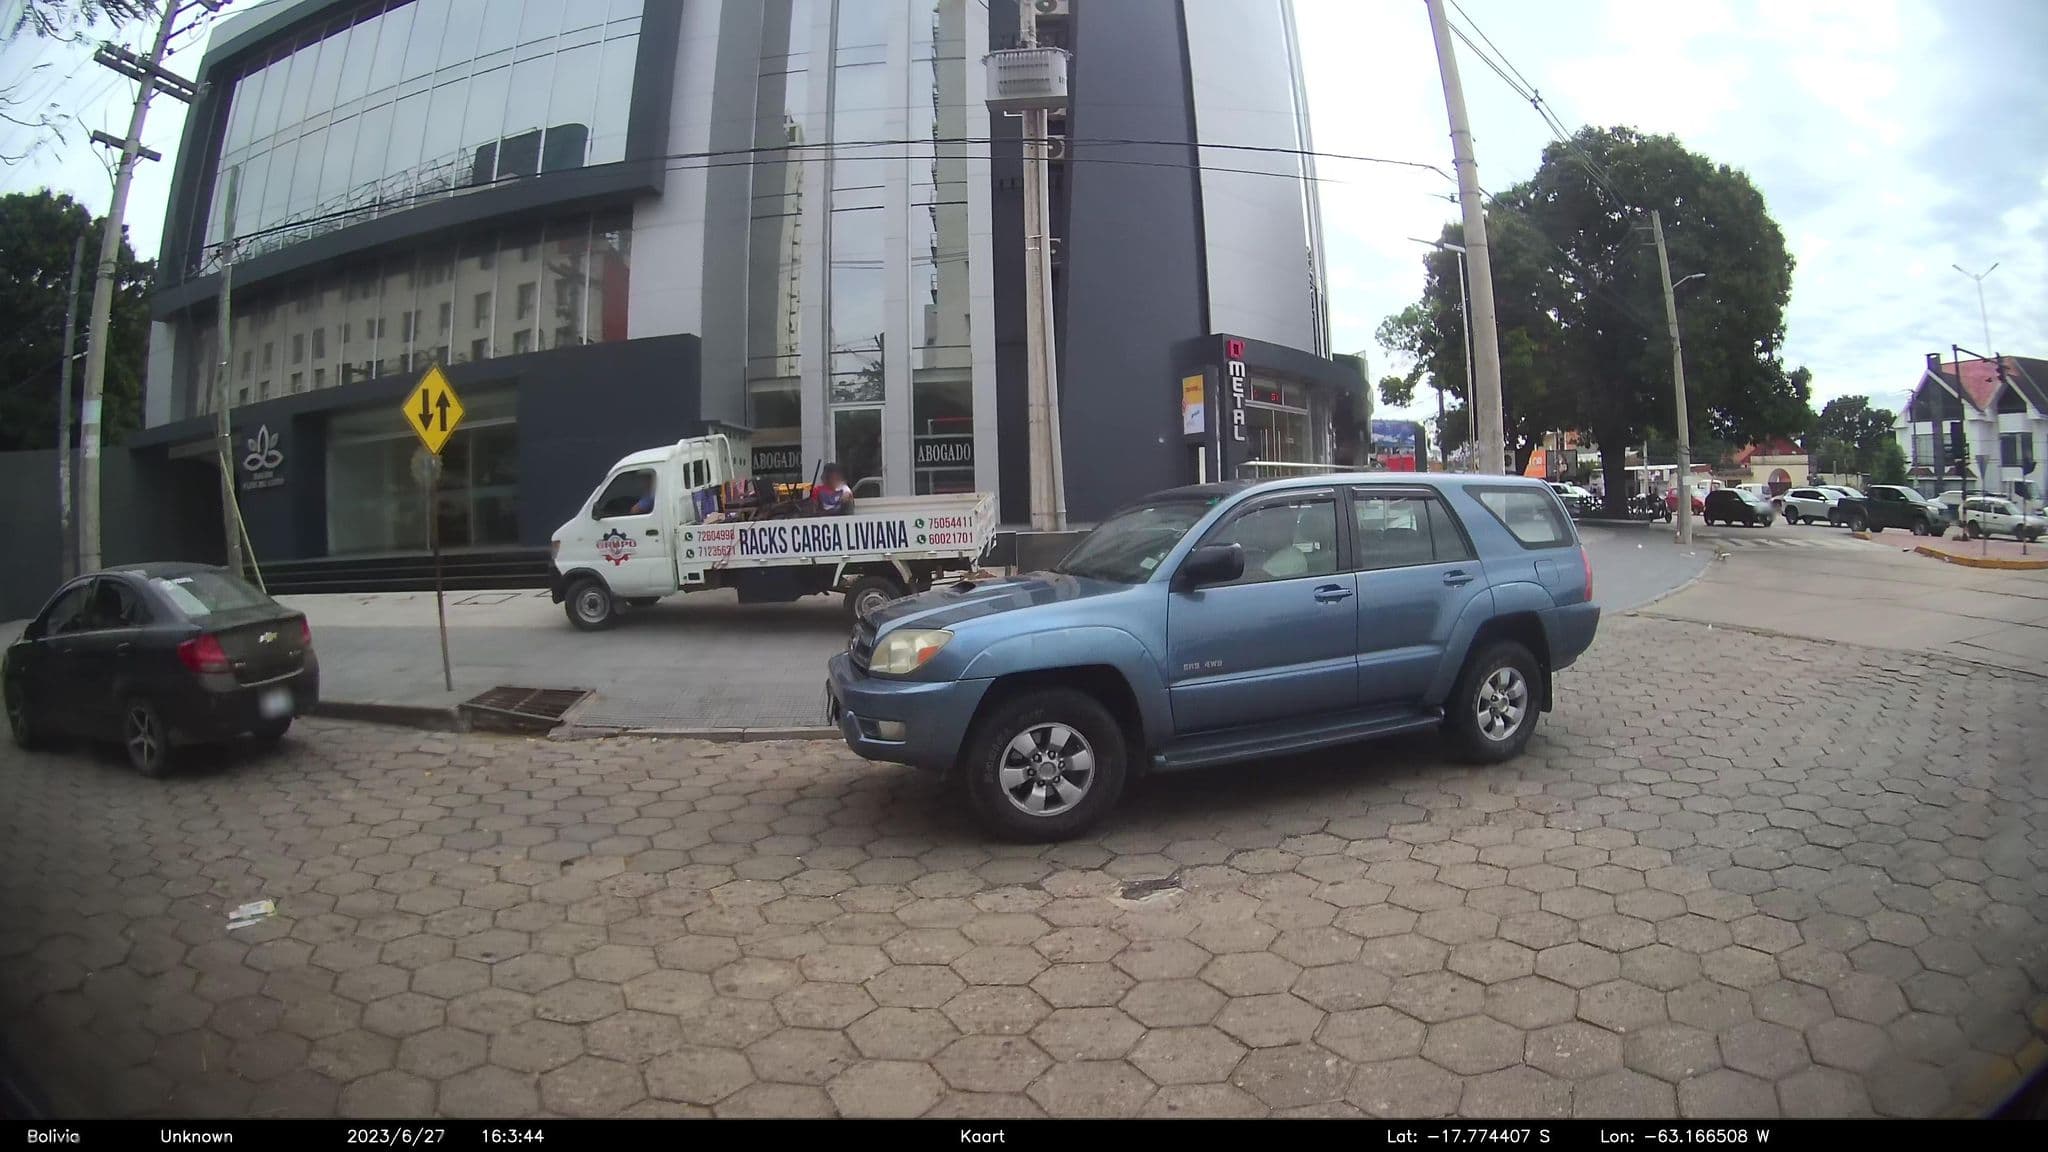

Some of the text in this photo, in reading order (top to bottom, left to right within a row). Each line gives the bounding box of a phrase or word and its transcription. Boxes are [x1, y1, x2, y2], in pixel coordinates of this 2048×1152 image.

[918, 443, 971, 462] ABOGADO
[928, 516, 972, 529] 75054411
[739, 520, 908, 555] RACKS CARGA LIVIANA
[929, 532, 973, 545] 60021701
